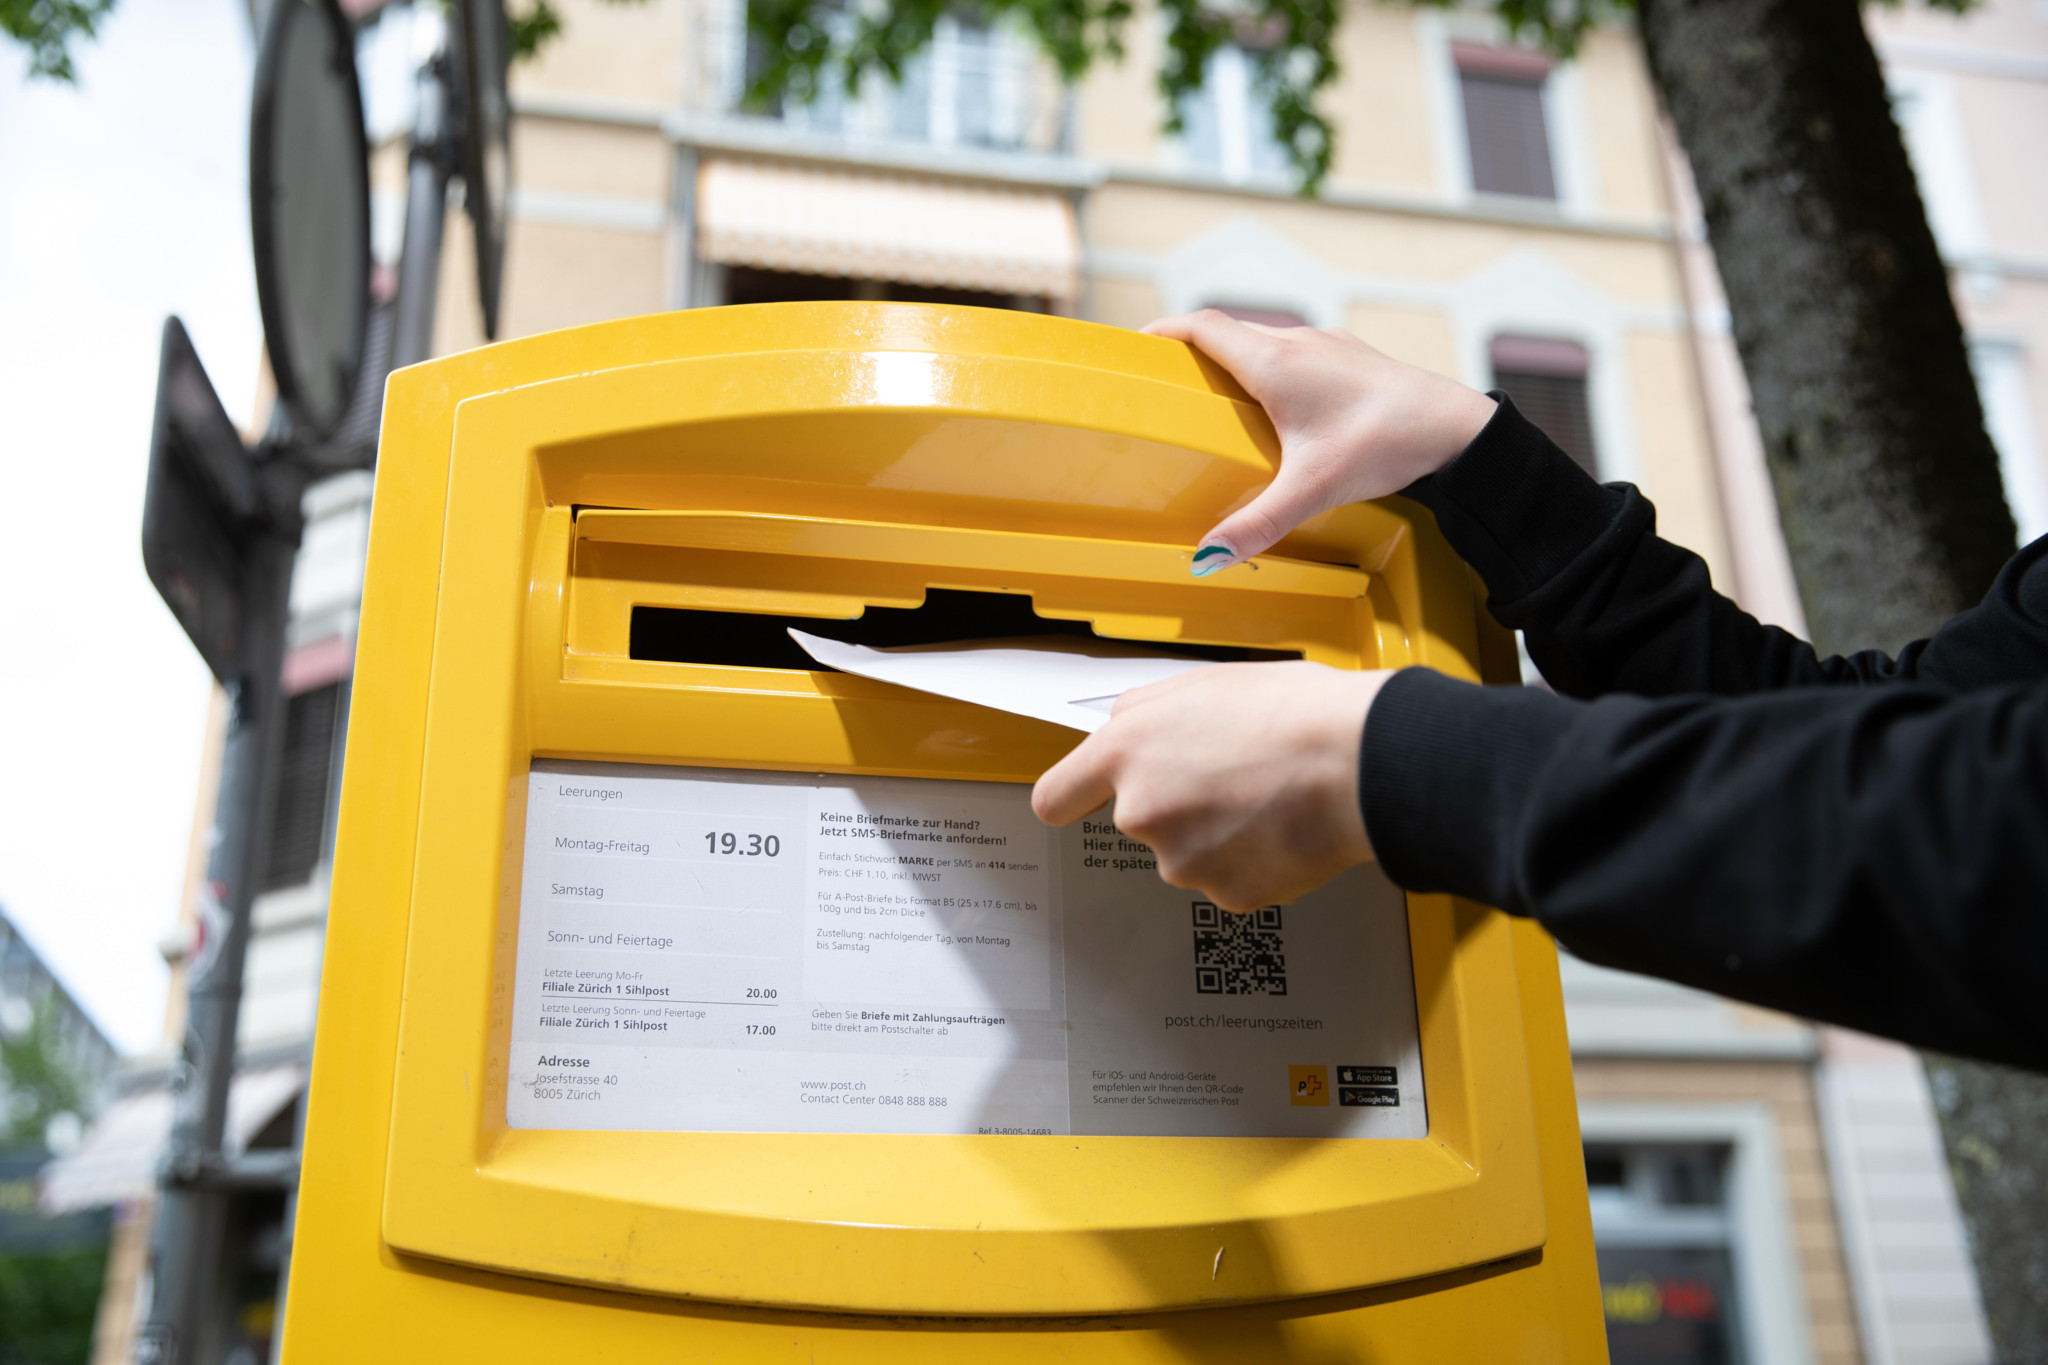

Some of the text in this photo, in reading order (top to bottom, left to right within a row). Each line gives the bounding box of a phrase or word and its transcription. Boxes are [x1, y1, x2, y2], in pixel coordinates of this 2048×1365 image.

[559, 785, 623, 801] Leerungen
[821, 812, 980, 830] Keine Briefmarke zur Hand?
[820, 827, 1006, 846] Jetzt SMS-Briefmarke anfordern!
[555, 831, 781, 857] Montag-Freitag 19.30
[1084, 839, 1113, 851] Hier
[819, 852, 851, 862] Einfach
[854, 854, 896, 864] Stichwort
[899, 857, 934, 865] MARKE
[937, 860, 951, 868] per
[953, 860, 972, 868] SMS
[989, 861, 1005, 869] 414
[1008, 862, 1039, 871] senden
[1084, 855, 1108, 867] der
[819, 868, 941, 881] Preis: CHF 1.10, inkl. MWST
[551, 883, 604, 899] Samstag
[818, 892, 832, 900] Für
[835, 893, 893, 904] A-Post-Briefe
[895, 895, 907, 905] bis
[910, 897, 941, 906] Format
[943, 898, 954, 907] B5
[957, 898, 971, 908] (25
[982, 900, 1001, 909] 17.6
[1004, 901, 1022, 911] cm),
[1025, 902, 1037, 911] bis
[818, 904, 925, 917] 100g und bis 2cm Dicke
[548, 931, 673, 949] Sonn- und Feiertage
[817, 929, 866, 940] Zustellung:
[869, 931, 932, 942] nachfolgender
[936, 934, 954, 944] Tag,
[976, 936, 1010, 947] Montag
[817, 941, 870, 952] bis Samstag
[545, 969, 643, 981] Letzte Leerung Mo-Fr
[542, 982, 777, 999] Filiale Zürich 1 Sihlpost 20.00
[542, 1004, 706, 1019] Letzte Leerung Sonn- und Feiertage
[812, 1010, 1005, 1027] Geben Sie Briefe mit Zahlungsaufträgen
[1165, 1014, 1323, 1032] post.ch/leerungszeiten
[539, 1017, 776, 1035] Filiale Zürich 1 Sihlpost 17.00
[811, 1022, 832, 1031] bitte
[835, 1023, 861, 1033] direkt
[881, 1024, 934, 1035] Postschalter
[937, 1027, 948, 1035] ab
[538, 1055, 590, 1067] Adresse
[534, 1073, 617, 1085] Josefstrasse 40
[1092, 1071, 1216, 1081] Für iOS- und Android-Geräte
[801, 1080, 866, 1091] www.post.ch
[1093, 1083, 1244, 1094] empfehlen wir Ihnen den QR-Code
[534, 1089, 601, 1100] 8005 Zürich
[801, 1093, 947, 1106] Contact Center 0848 888 888
[1093, 1095, 1239, 1105] Scanner der Schweizerischen Post
[1357, 1096, 1395, 1104] Google Play
